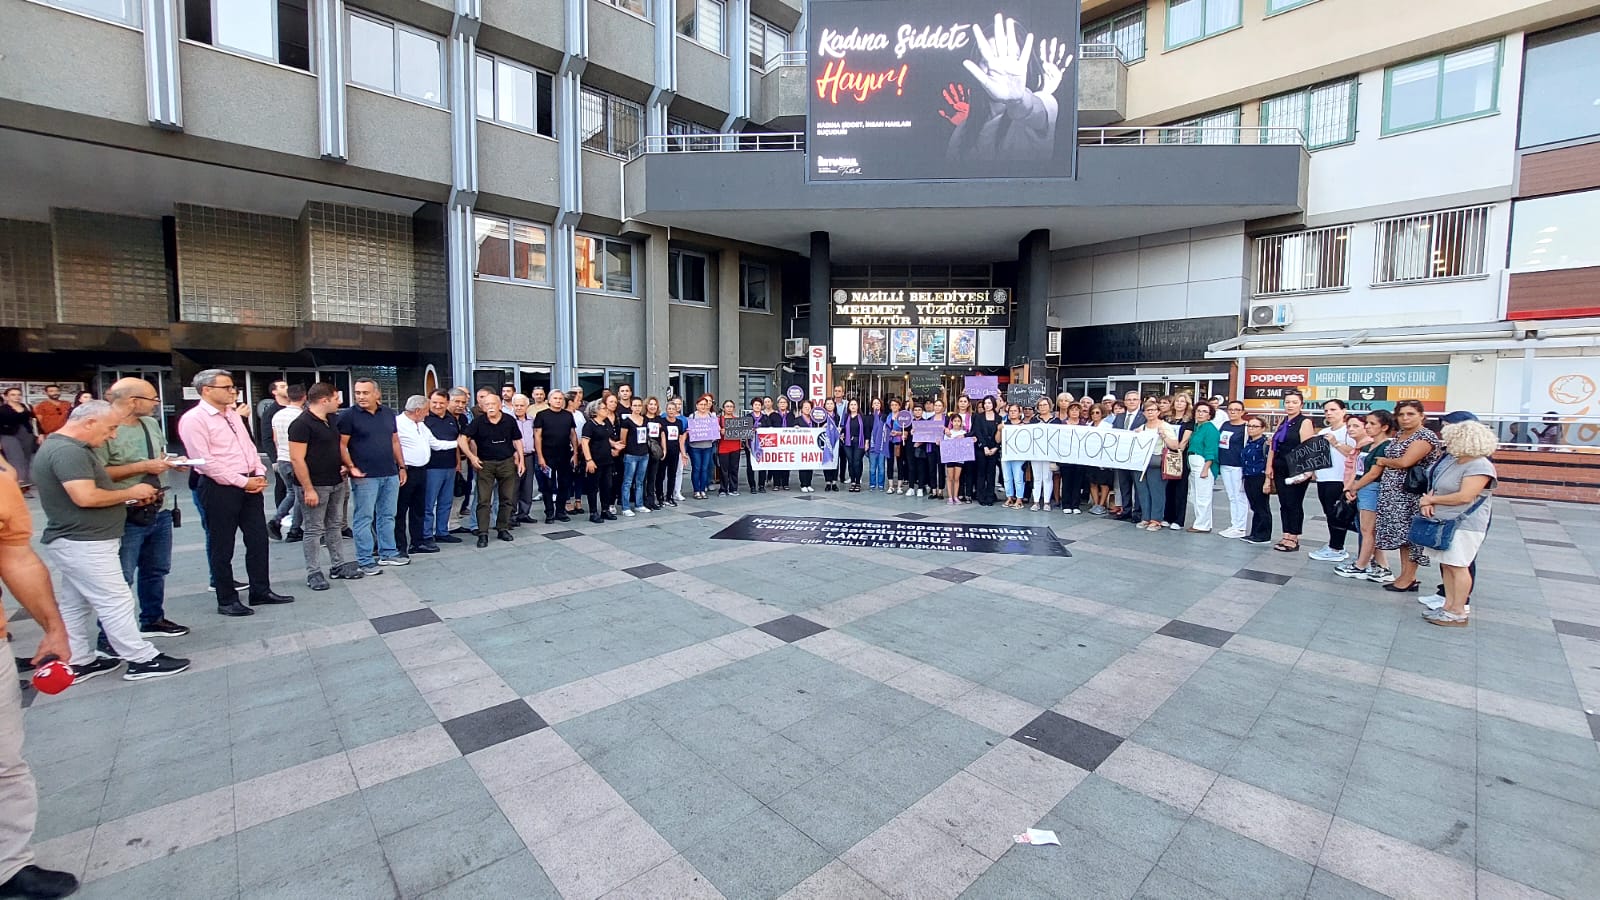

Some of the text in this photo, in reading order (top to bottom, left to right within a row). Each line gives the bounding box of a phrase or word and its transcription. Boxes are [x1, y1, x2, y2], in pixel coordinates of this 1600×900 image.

[818, 23, 971, 59] Kadına Şiddete
[816, 59, 908, 104] Hayır!
[851, 290, 990, 302] NAZİLLİ BELEDİYESİ
[835, 302, 1006, 315] MEHMET YÜZÜGÜLER
[850, 314, 990, 325] KÜLTÜR MERKEZİ
[811, 347, 824, 408] SİNEM
[1255, 388, 1282, 397] 12 SAAT
[780, 434, 814, 446] KADINA
[1004, 427, 1154, 466] KORKUYORUM
[801, 451, 824, 463] HAYI
[824, 520, 891, 529] hayattan
[896, 523, 963, 532] koparan
[955, 531, 1030, 541] zihniyeti
